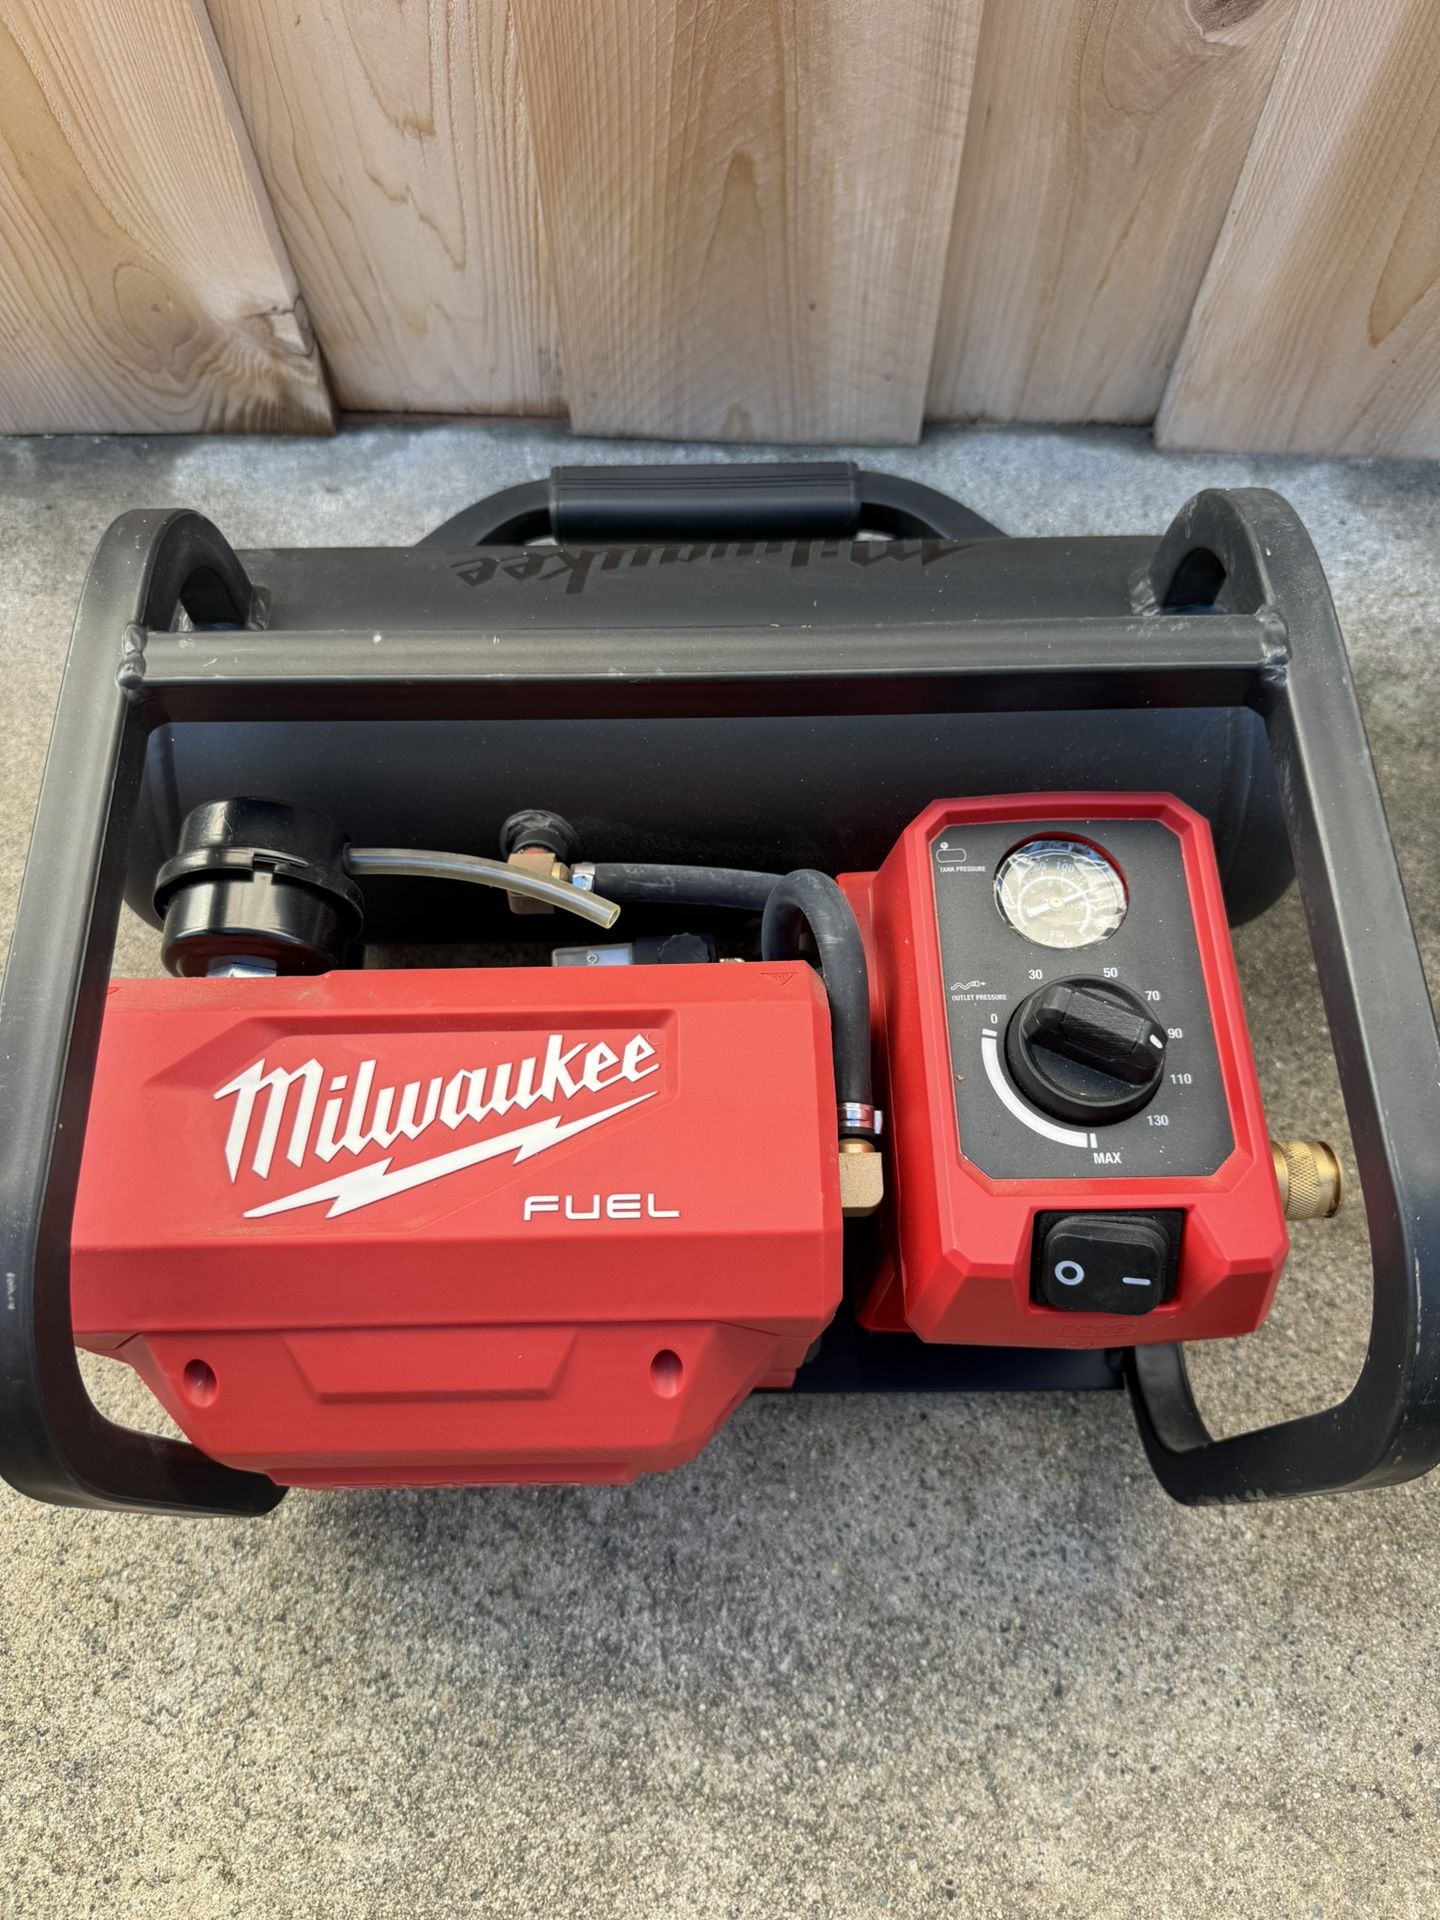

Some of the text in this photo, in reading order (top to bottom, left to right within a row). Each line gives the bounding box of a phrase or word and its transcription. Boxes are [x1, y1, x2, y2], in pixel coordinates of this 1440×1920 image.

[1028, 969, 1043, 980] 30
[1103, 967, 1118, 978] 50
[1145, 990, 1160, 1001] 70
[990, 1013, 998, 1024] 0
[1167, 1028, 1183, 1039] 90
[1170, 1073, 1192, 1084] 110
[214, 1034, 660, 1183] Milwaukee
[1146, 1114, 1169, 1126] 130
[1093, 1152, 1122, 1164] MAX
[523, 1193, 680, 1221] FUEL
